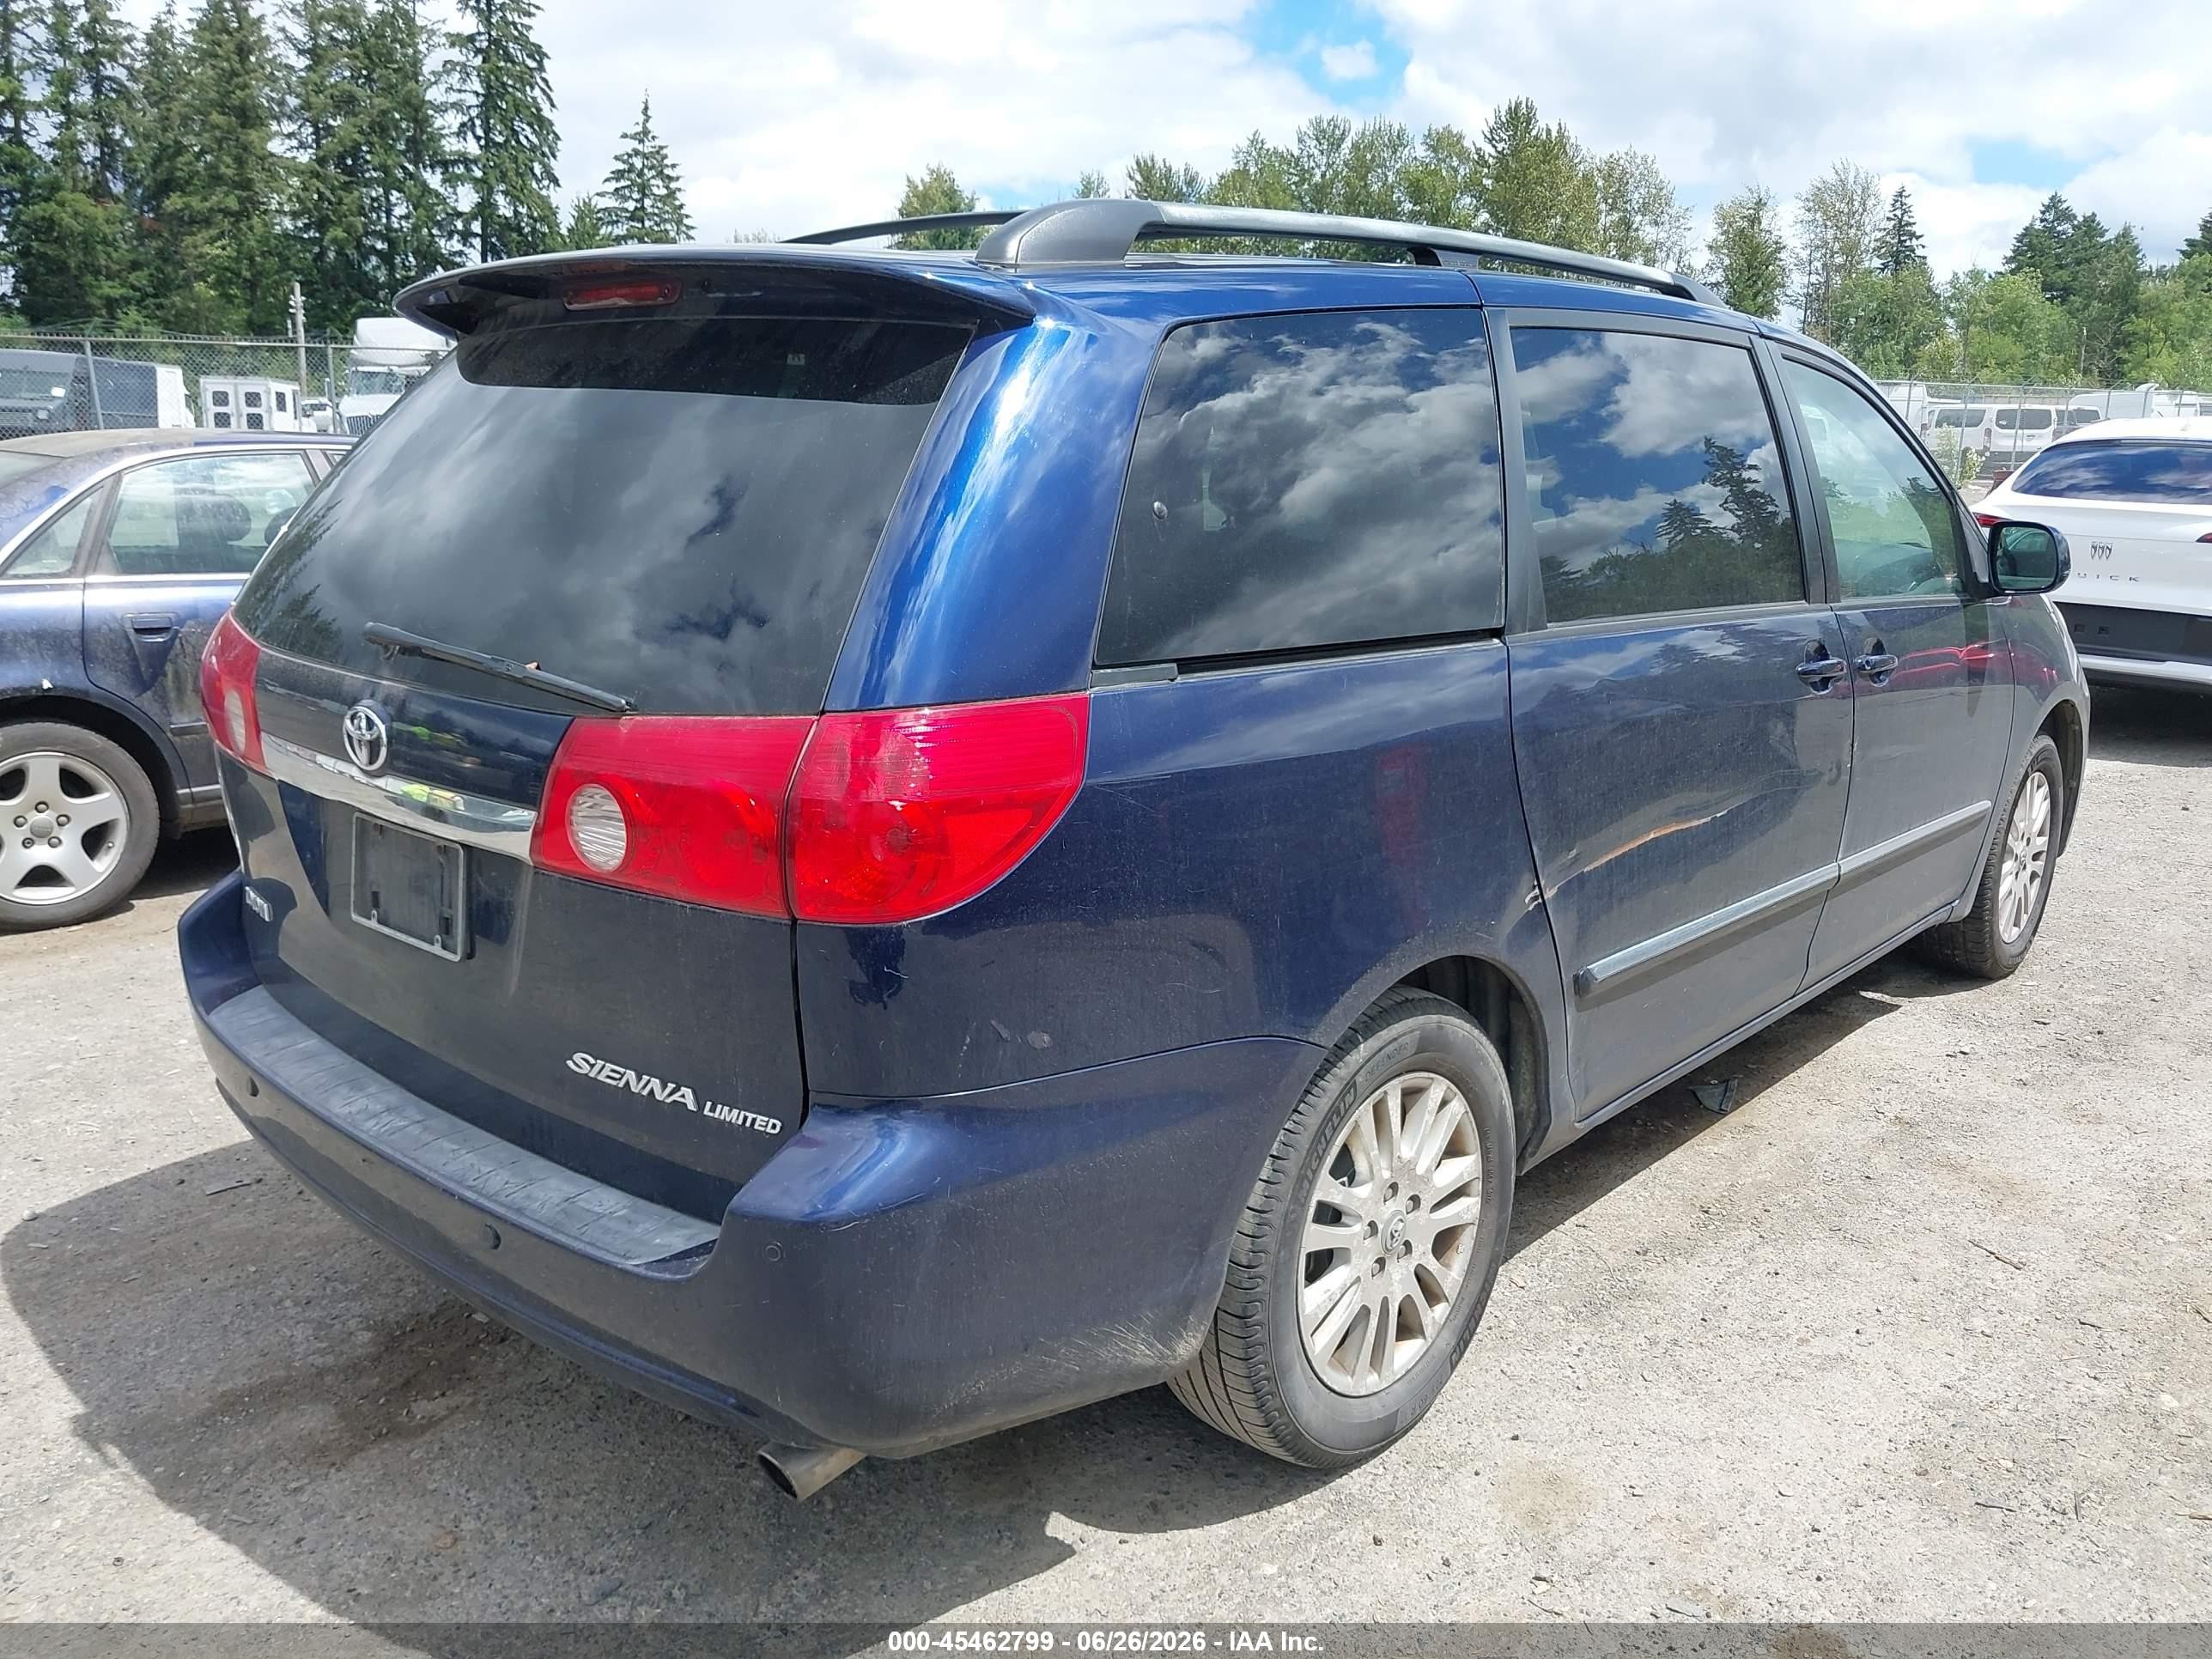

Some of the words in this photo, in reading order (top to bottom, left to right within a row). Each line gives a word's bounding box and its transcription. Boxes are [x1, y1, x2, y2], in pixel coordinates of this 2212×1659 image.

[2076, 572, 2141, 582] UICK
[1364, 1042, 1409, 1082] DEFENDER
[565, 1052, 700, 1112] SIENNA
[703, 1101, 782, 1134] LIMITED
[1298, 1085, 1356, 1203] MICHELIN
